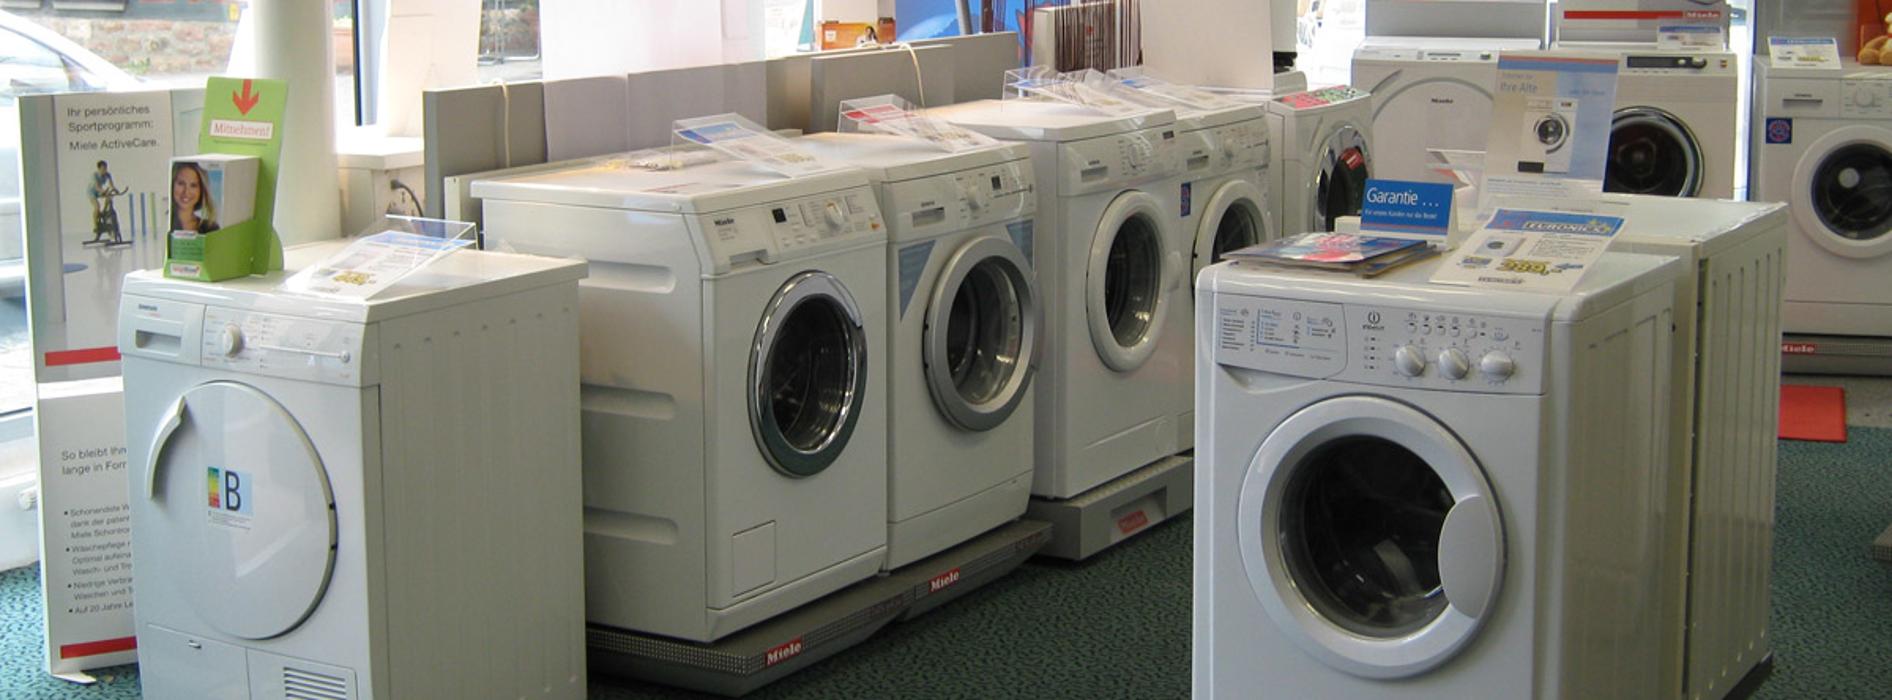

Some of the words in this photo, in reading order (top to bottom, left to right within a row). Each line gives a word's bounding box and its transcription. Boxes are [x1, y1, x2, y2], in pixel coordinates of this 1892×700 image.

[67, 107, 81, 117] Ihr
[84, 105, 151, 118] persönliches
[68, 121, 154, 133] Sportprogramm:
[213, 122, 270, 137] Mitnehmen!
[69, 141, 98, 151] Miele
[1366, 187, 1418, 206] Garantie
[62, 450, 76, 460] So
[79, 447, 108, 459] bleibt
[62, 465, 91, 476] lange
[93, 463, 103, 471] in
[225, 470, 241, 511] B
[930, 571, 960, 592] Miele
[111, 588, 126, 596] und
[75, 605, 88, 614] Auf
[766, 640, 802, 666] Miele
